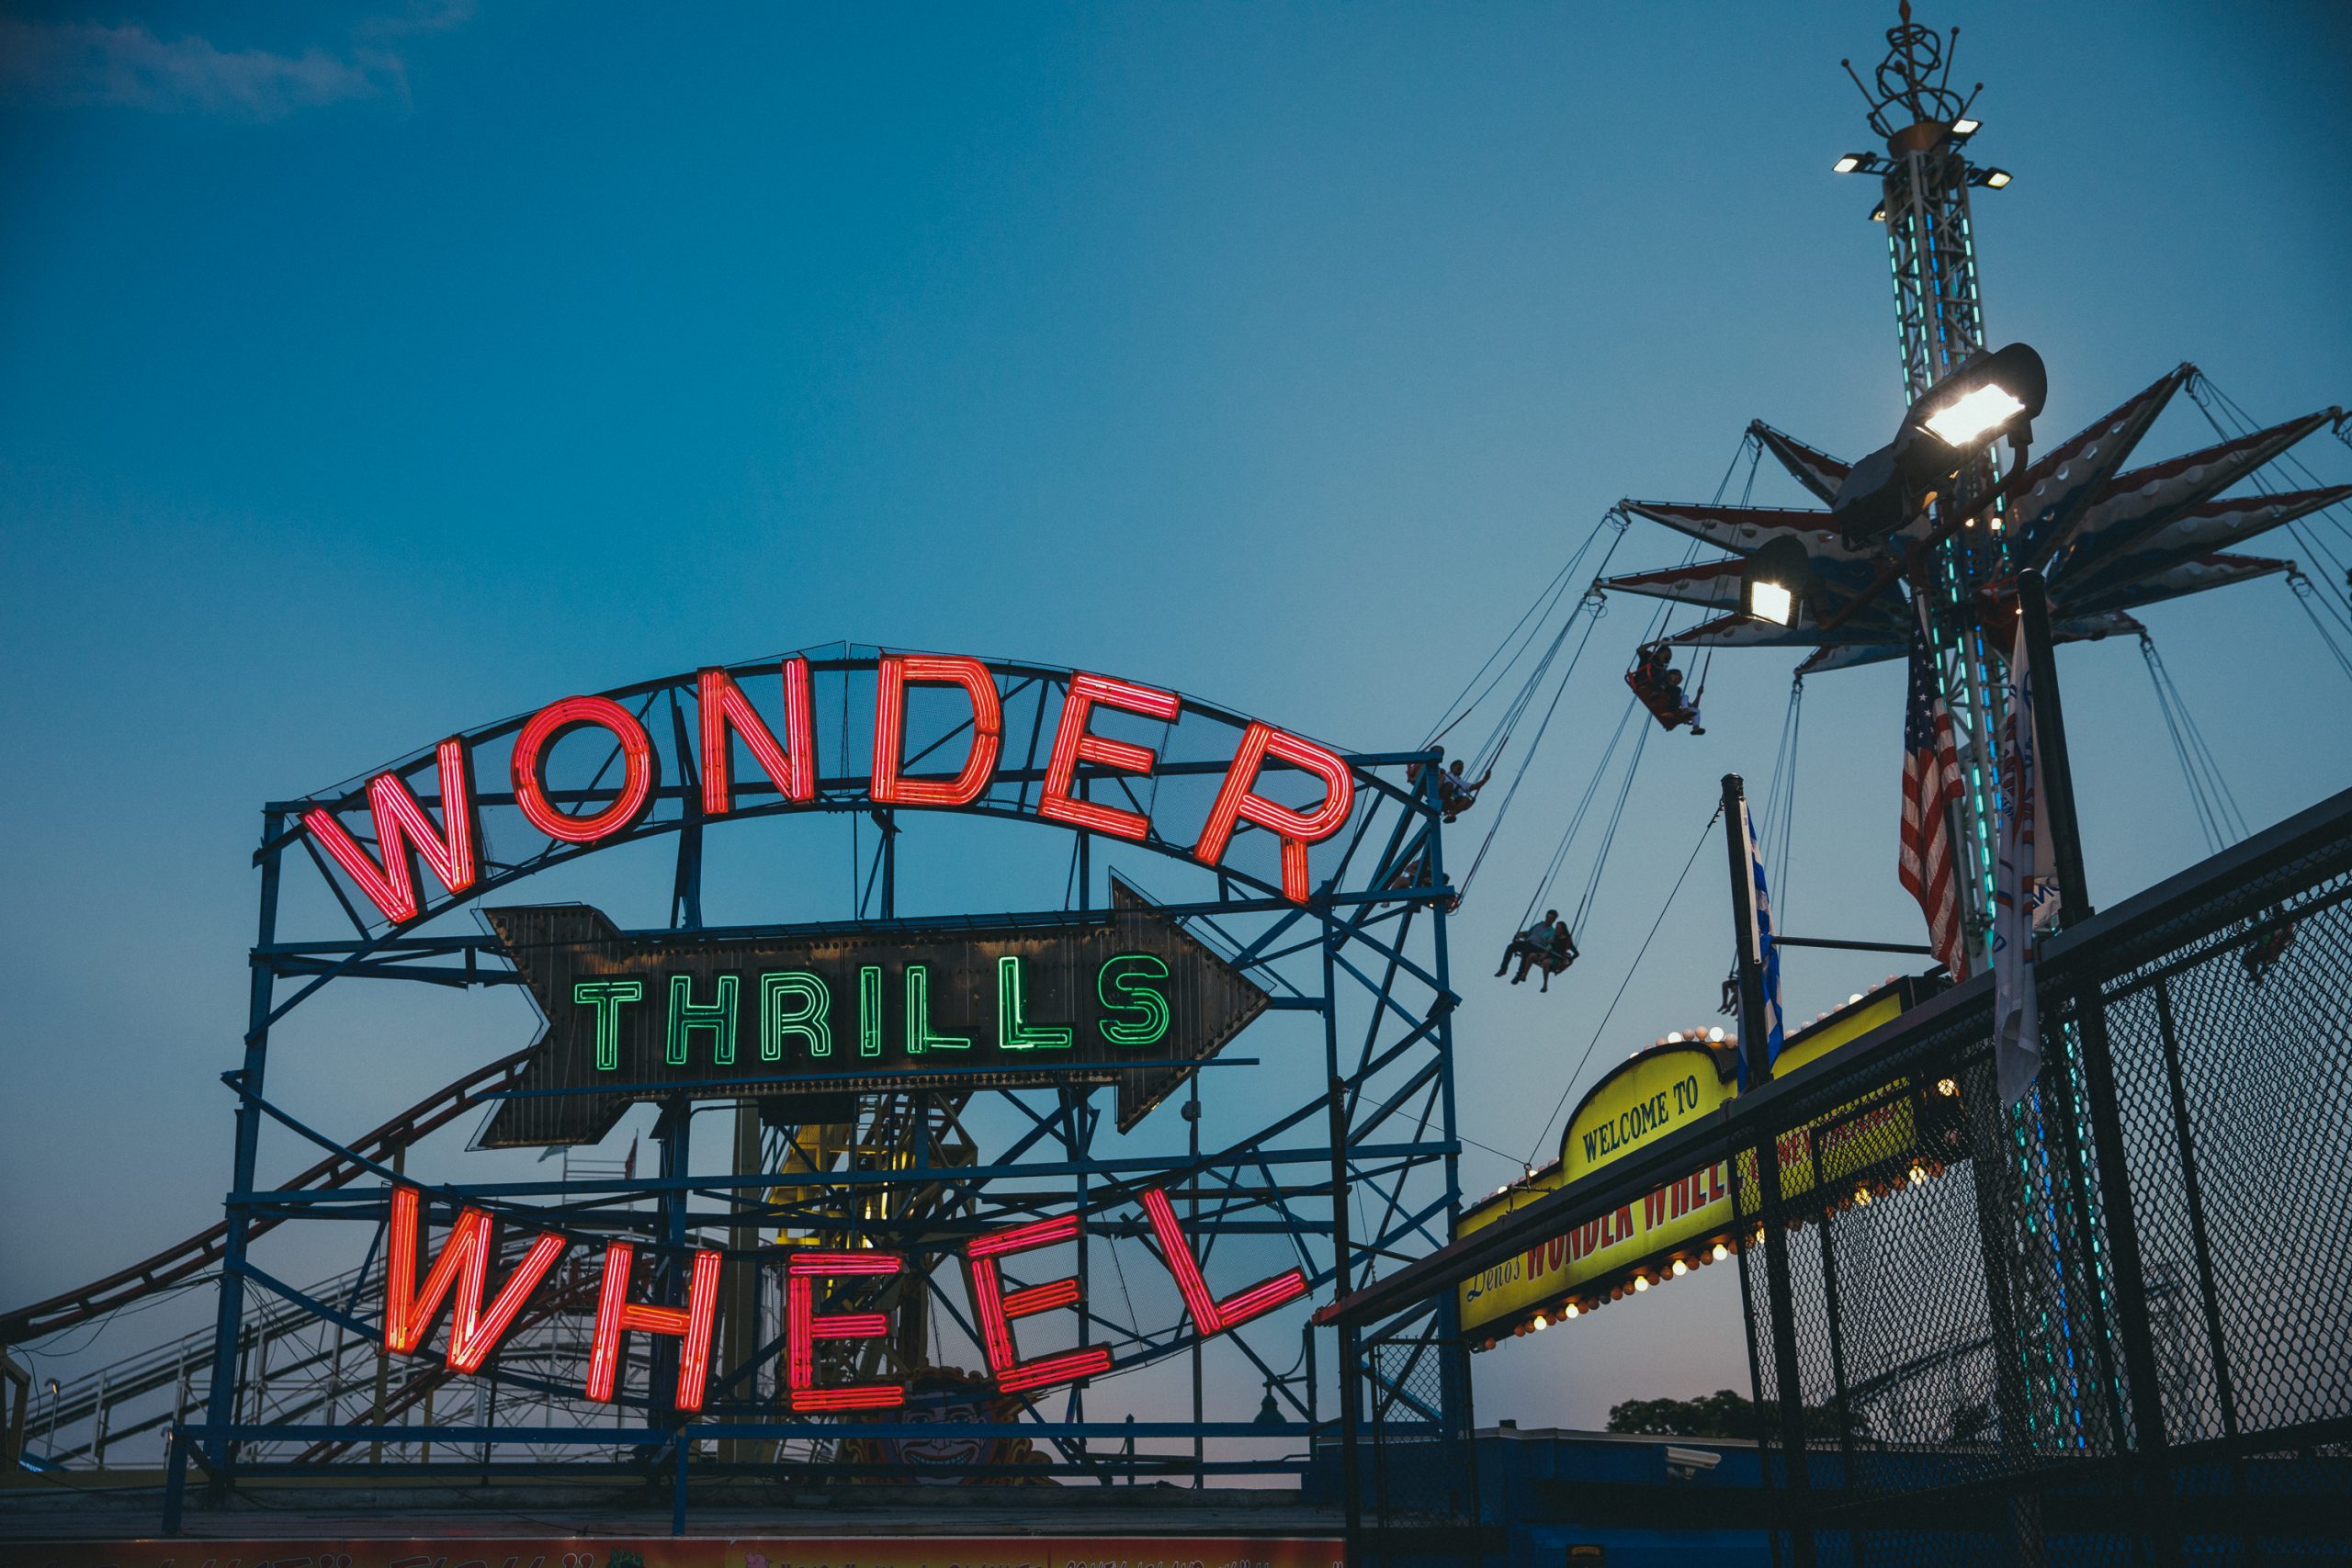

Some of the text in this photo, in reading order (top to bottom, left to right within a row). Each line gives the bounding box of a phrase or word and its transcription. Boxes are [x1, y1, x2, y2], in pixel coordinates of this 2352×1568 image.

[303, 654, 1355, 924] WONDER
[573, 954, 1170, 1072] THRILLS
[1582, 1074, 1699, 1164] WELCOME TO
[384, 1187, 1308, 1413] WHEEL
